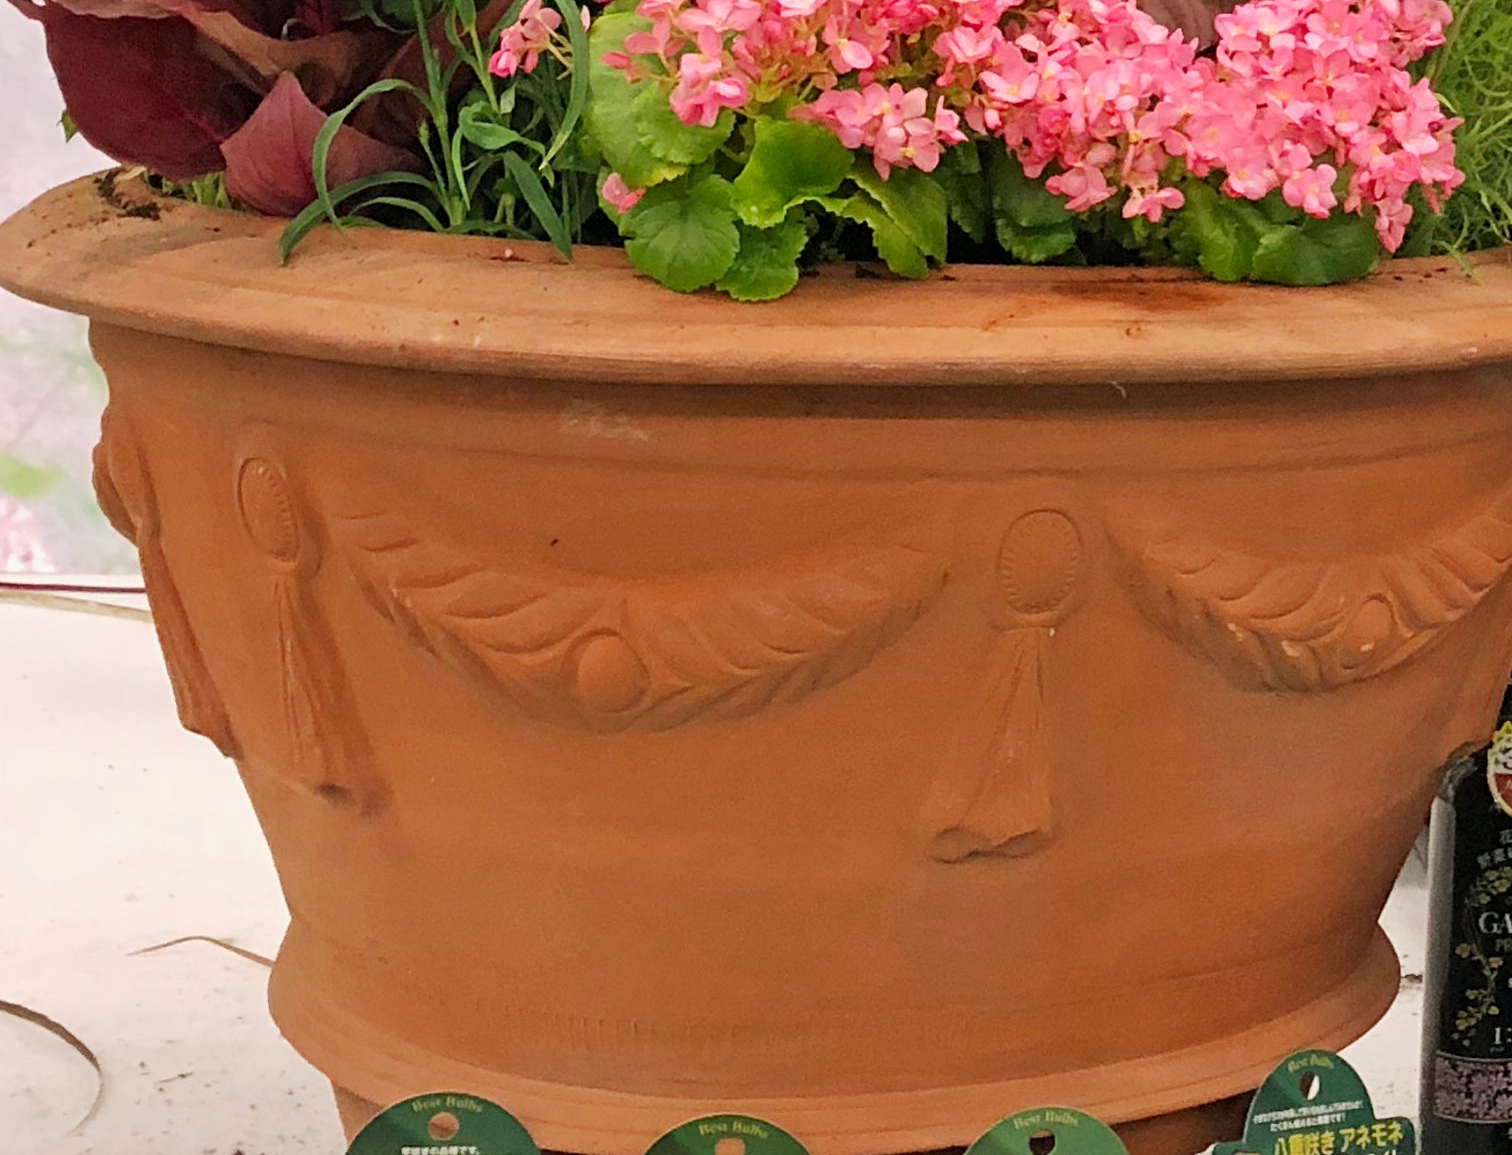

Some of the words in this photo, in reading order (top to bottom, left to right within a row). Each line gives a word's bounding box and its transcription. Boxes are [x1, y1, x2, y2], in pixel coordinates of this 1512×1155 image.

[411, 1098, 441, 1112] Best
[446, 1095, 483, 1112] Bulbs
[698, 1122, 728, 1136] Best
[732, 1120, 769, 1139] Bulbs
[1013, 1114, 1041, 1130] Best
[1045, 1111, 1080, 1127] Bulbs
[1339, 1121, 1403, 1153] アネモネ
